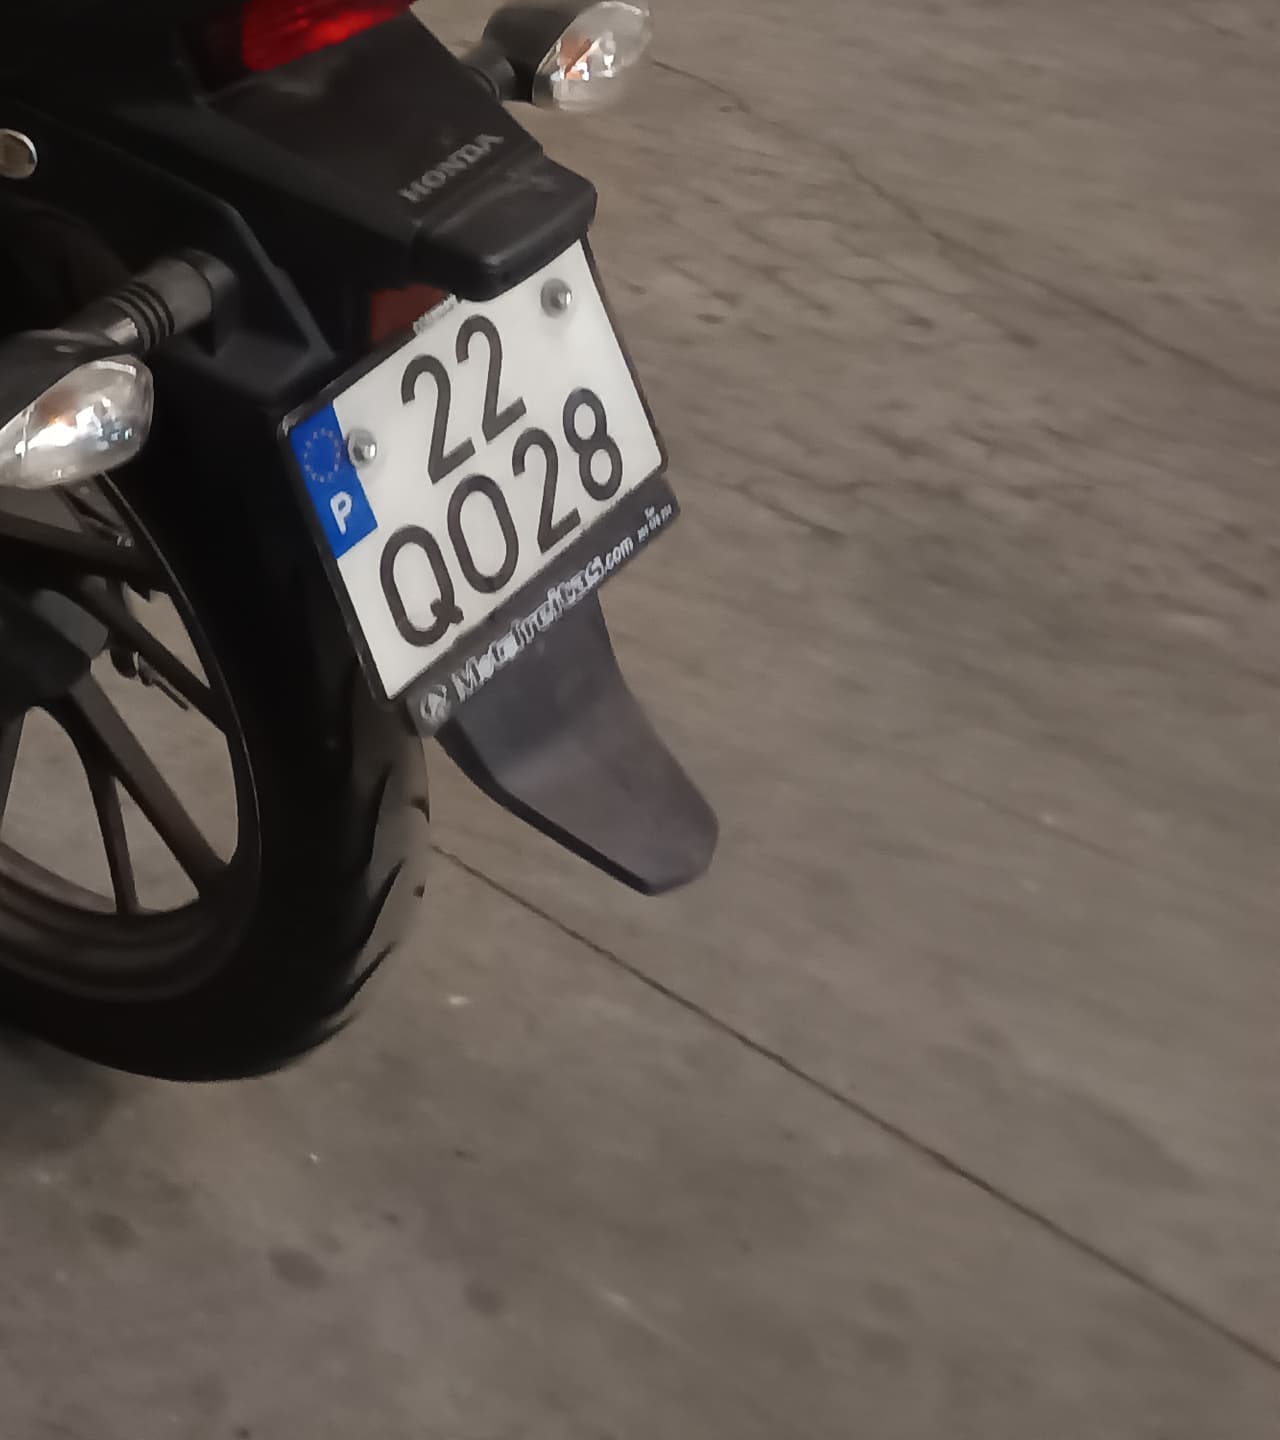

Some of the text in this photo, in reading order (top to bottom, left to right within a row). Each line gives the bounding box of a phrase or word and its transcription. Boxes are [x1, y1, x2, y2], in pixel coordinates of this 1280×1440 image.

[397, 133, 505, 204] HONDA
[401, 314, 527, 485] 22
[329, 491, 354, 535] P
[380, 387, 624, 647] QO28
